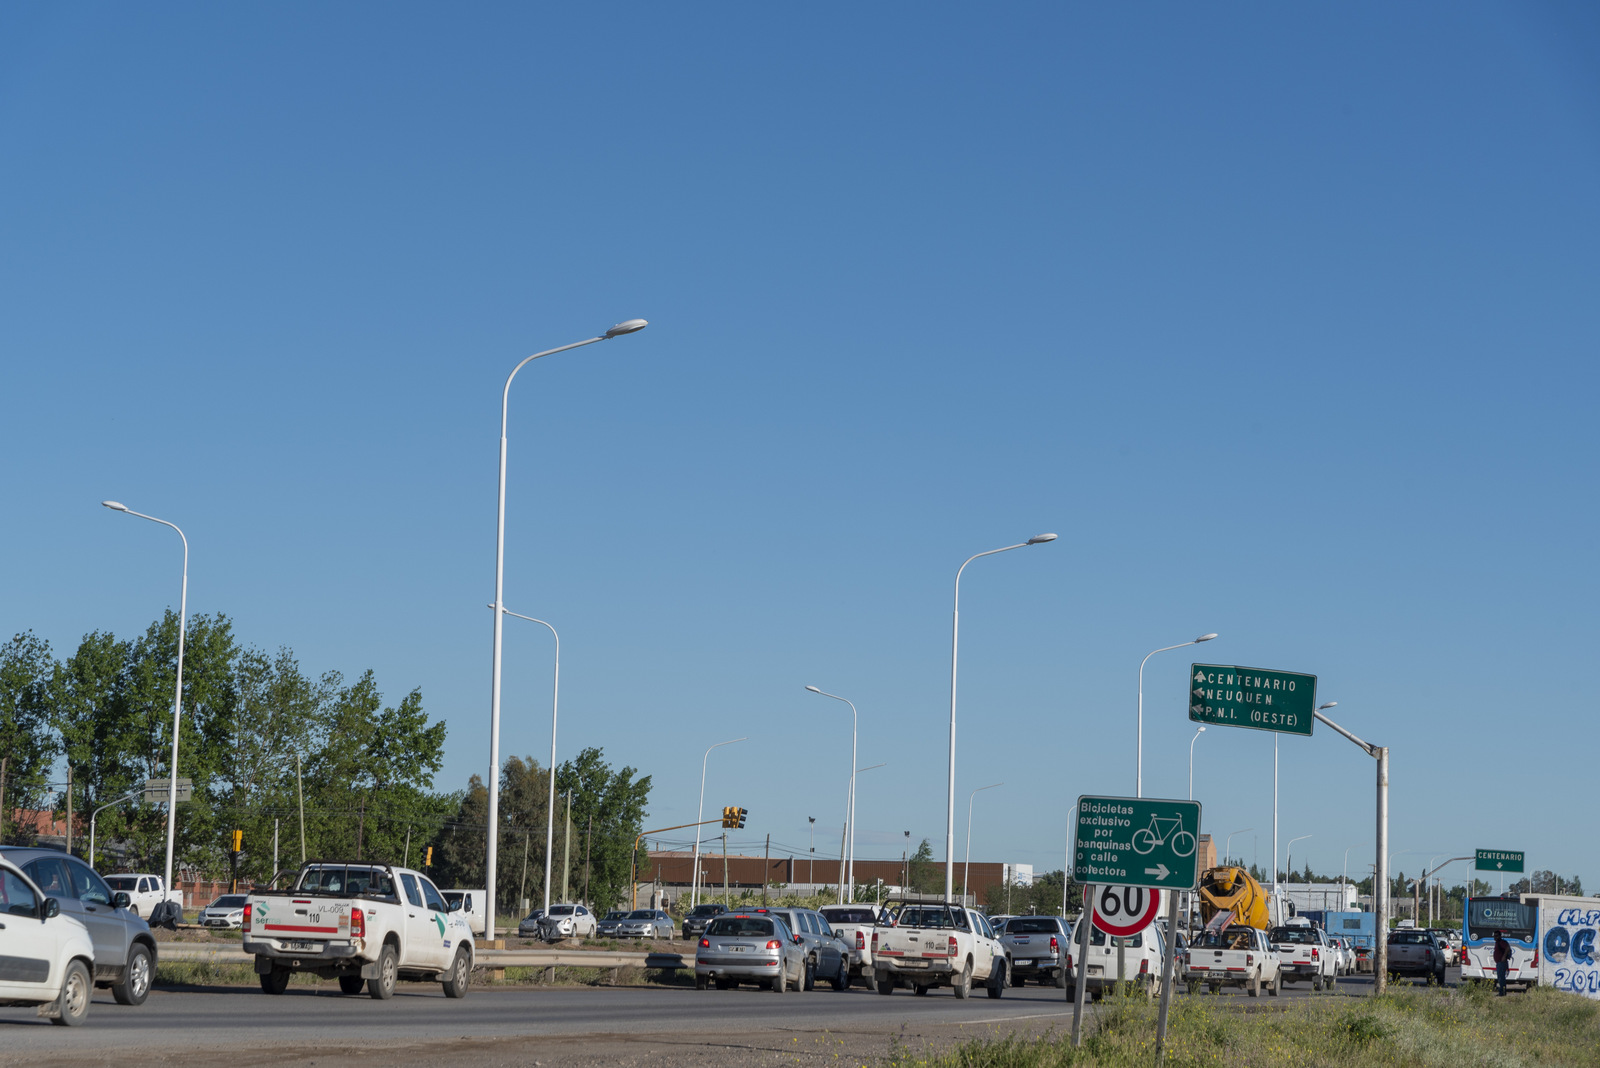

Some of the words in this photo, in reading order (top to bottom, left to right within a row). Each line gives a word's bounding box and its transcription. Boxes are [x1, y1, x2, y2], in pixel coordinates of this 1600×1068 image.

[1208, 673, 1296, 692] CENTENARIO
[1206, 689, 1273, 706] NEUQUEN
[1205, 706, 1238, 720] P.N.I.
[1250, 709, 1298, 727] (OESTE)
[1081, 802, 1134, 814] Bicicletas
[1080, 816, 1131, 827] exclusivo
[1094, 828, 1113, 838] por
[1078, 839, 1131, 851] banquinas
[1077, 853, 1083, 861] o
[1091, 852, 1118, 862] calle
[1478, 851, 1522, 861] CENTENARIO
[1076, 864, 1126, 877] colectora
[1101, 885, 1143, 917] 60
[309, 913, 320, 924] 110
[925, 941, 935, 949] 110
[1554, 967, 1600, 993] 201
